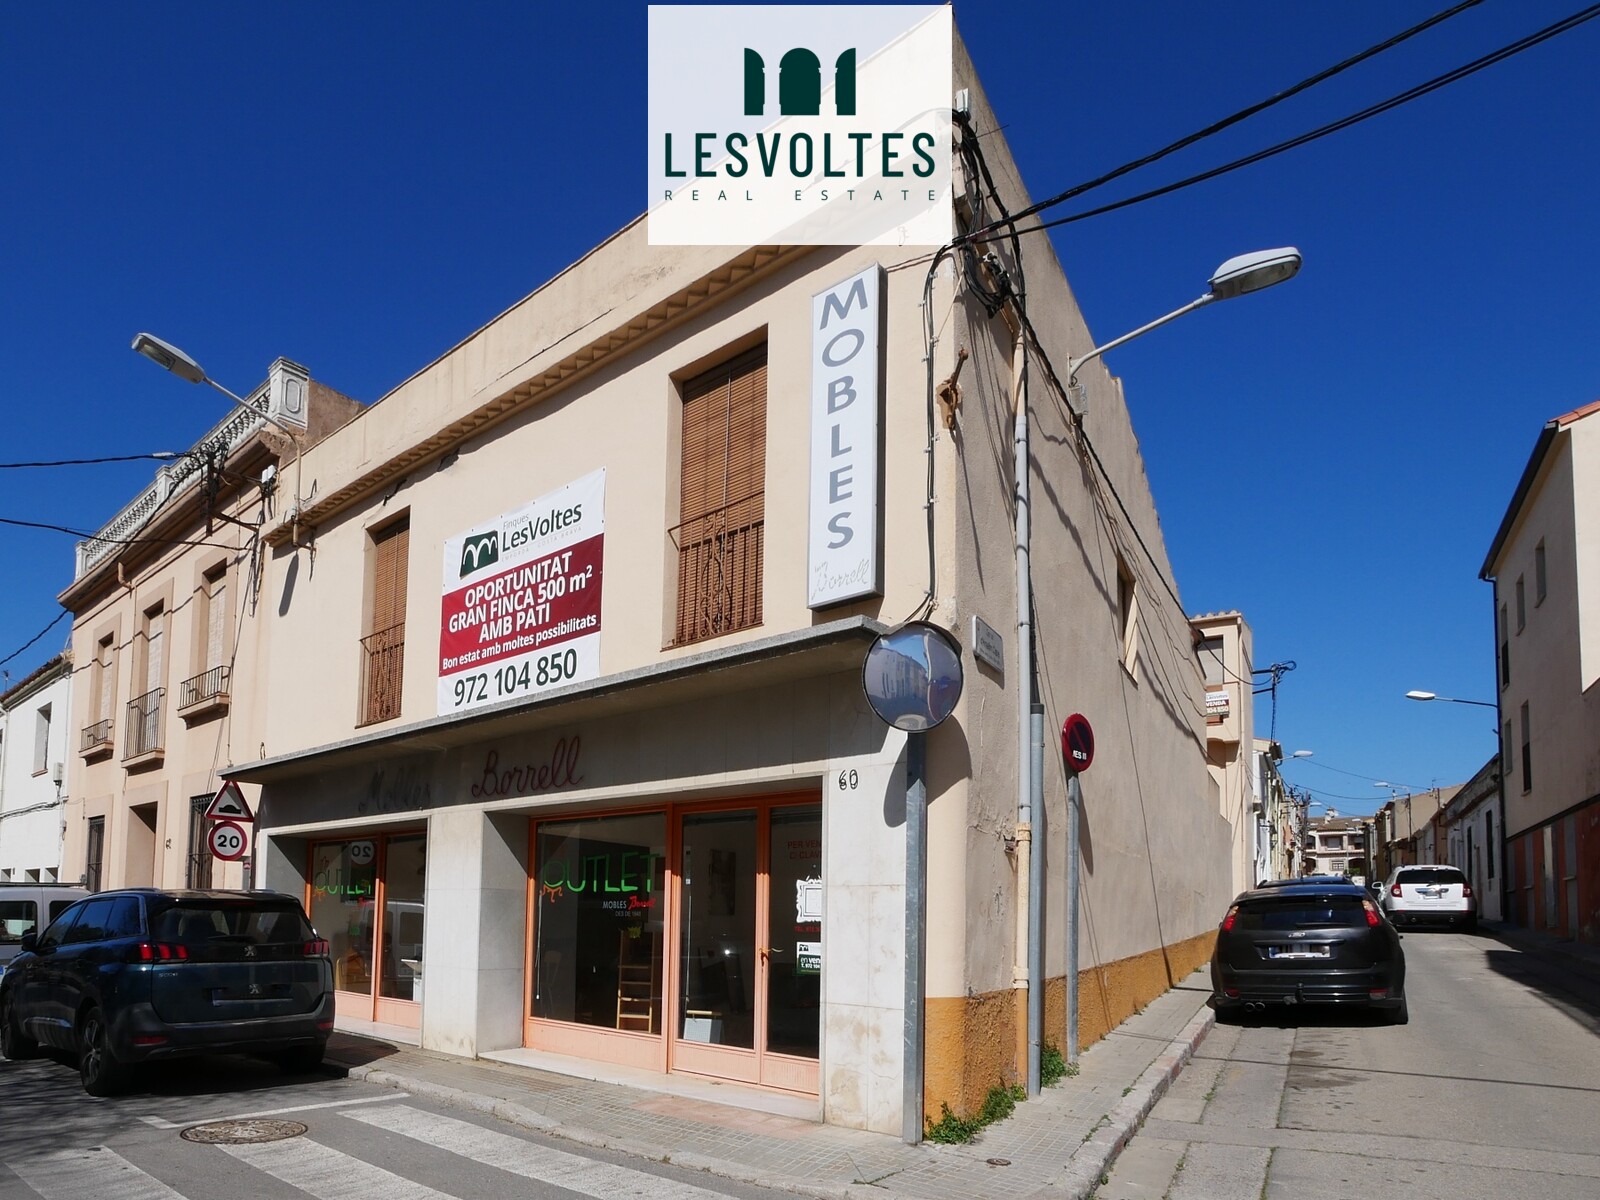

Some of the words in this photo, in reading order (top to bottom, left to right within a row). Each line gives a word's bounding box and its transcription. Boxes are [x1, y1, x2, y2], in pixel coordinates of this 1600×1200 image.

[819, 278, 869, 550] MOBLES
[502, 503, 582, 553] LesVoltes
[503, 514, 529, 531] Finques
[449, 604, 486, 633] GRAN
[490, 590, 534, 620] FINCA
[538, 576, 566, 604] 500
[465, 551, 573, 608] OPORTUNITAT
[442, 658, 458, 670] Bon
[459, 651, 480, 664] estat
[482, 643, 500, 658] amb
[502, 635, 534, 652] moltes
[535, 614, 597, 646] possibilitats
[479, 616, 512, 643] AMB
[516, 603, 550, 631] PATI
[454, 672, 488, 706] 972
[494, 661, 531, 696] 104
[536, 648, 577, 686] 850
[471, 735, 584, 798] Borrell
[838, 769, 858, 790] 60
[218, 834, 240, 849] 20
[542, 852, 660, 893] OUTLET
[602, 901, 627, 909] MOBLES
